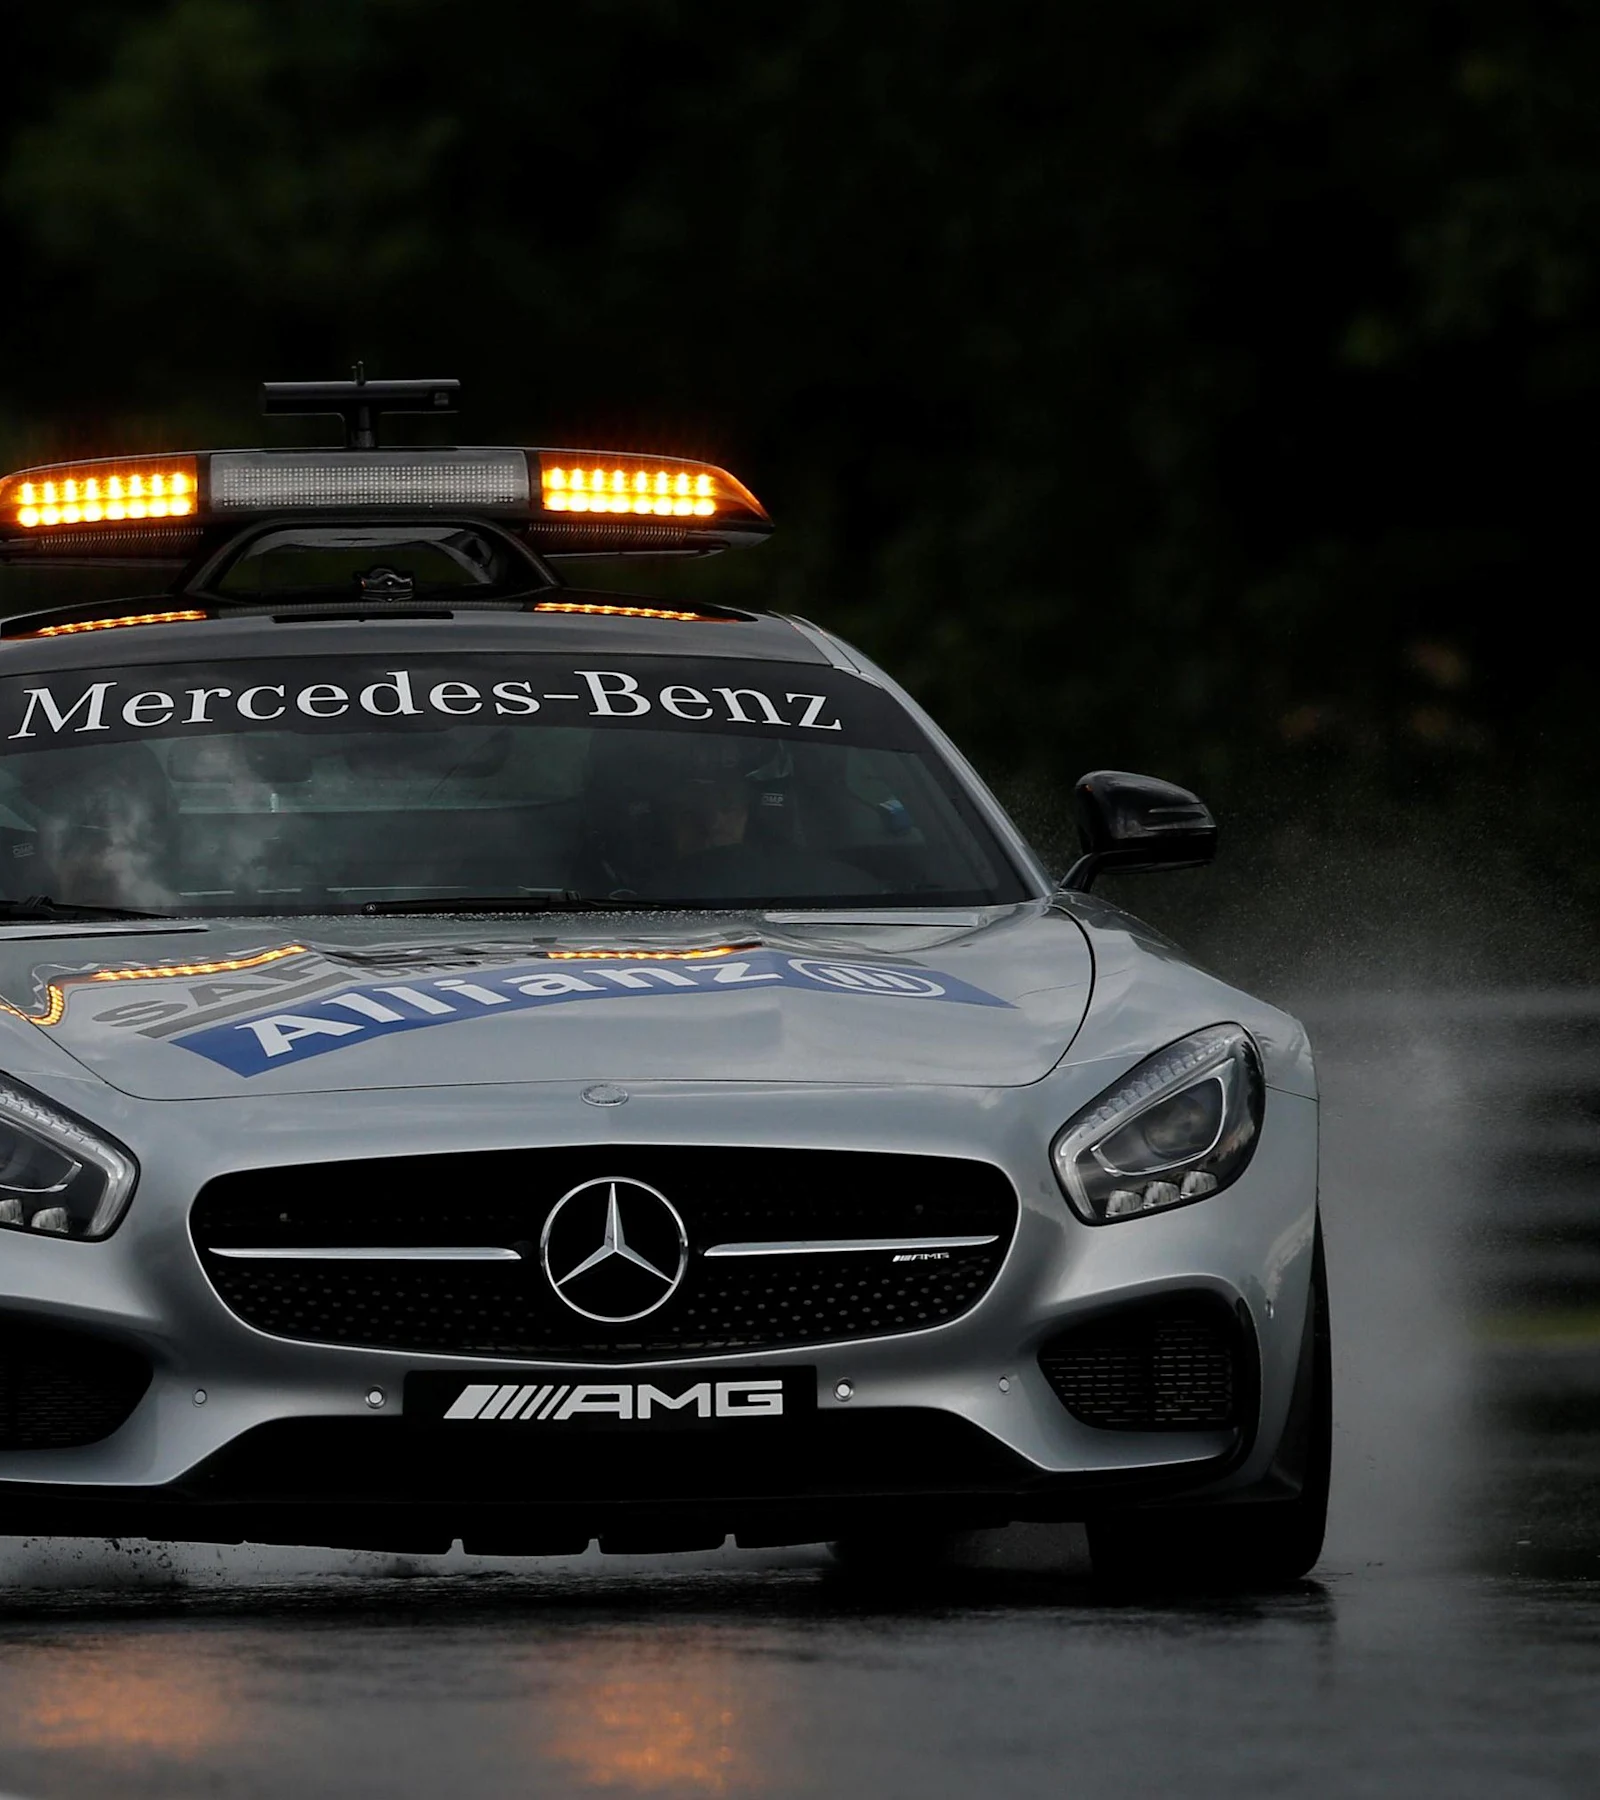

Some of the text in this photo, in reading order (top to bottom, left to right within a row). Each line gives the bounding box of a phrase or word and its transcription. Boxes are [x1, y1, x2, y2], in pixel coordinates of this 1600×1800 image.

[6, 669, 844, 739] Mercedes-Benz
[234, 961, 784, 1058] Allianz
[552, 1380, 784, 1420] AMG
